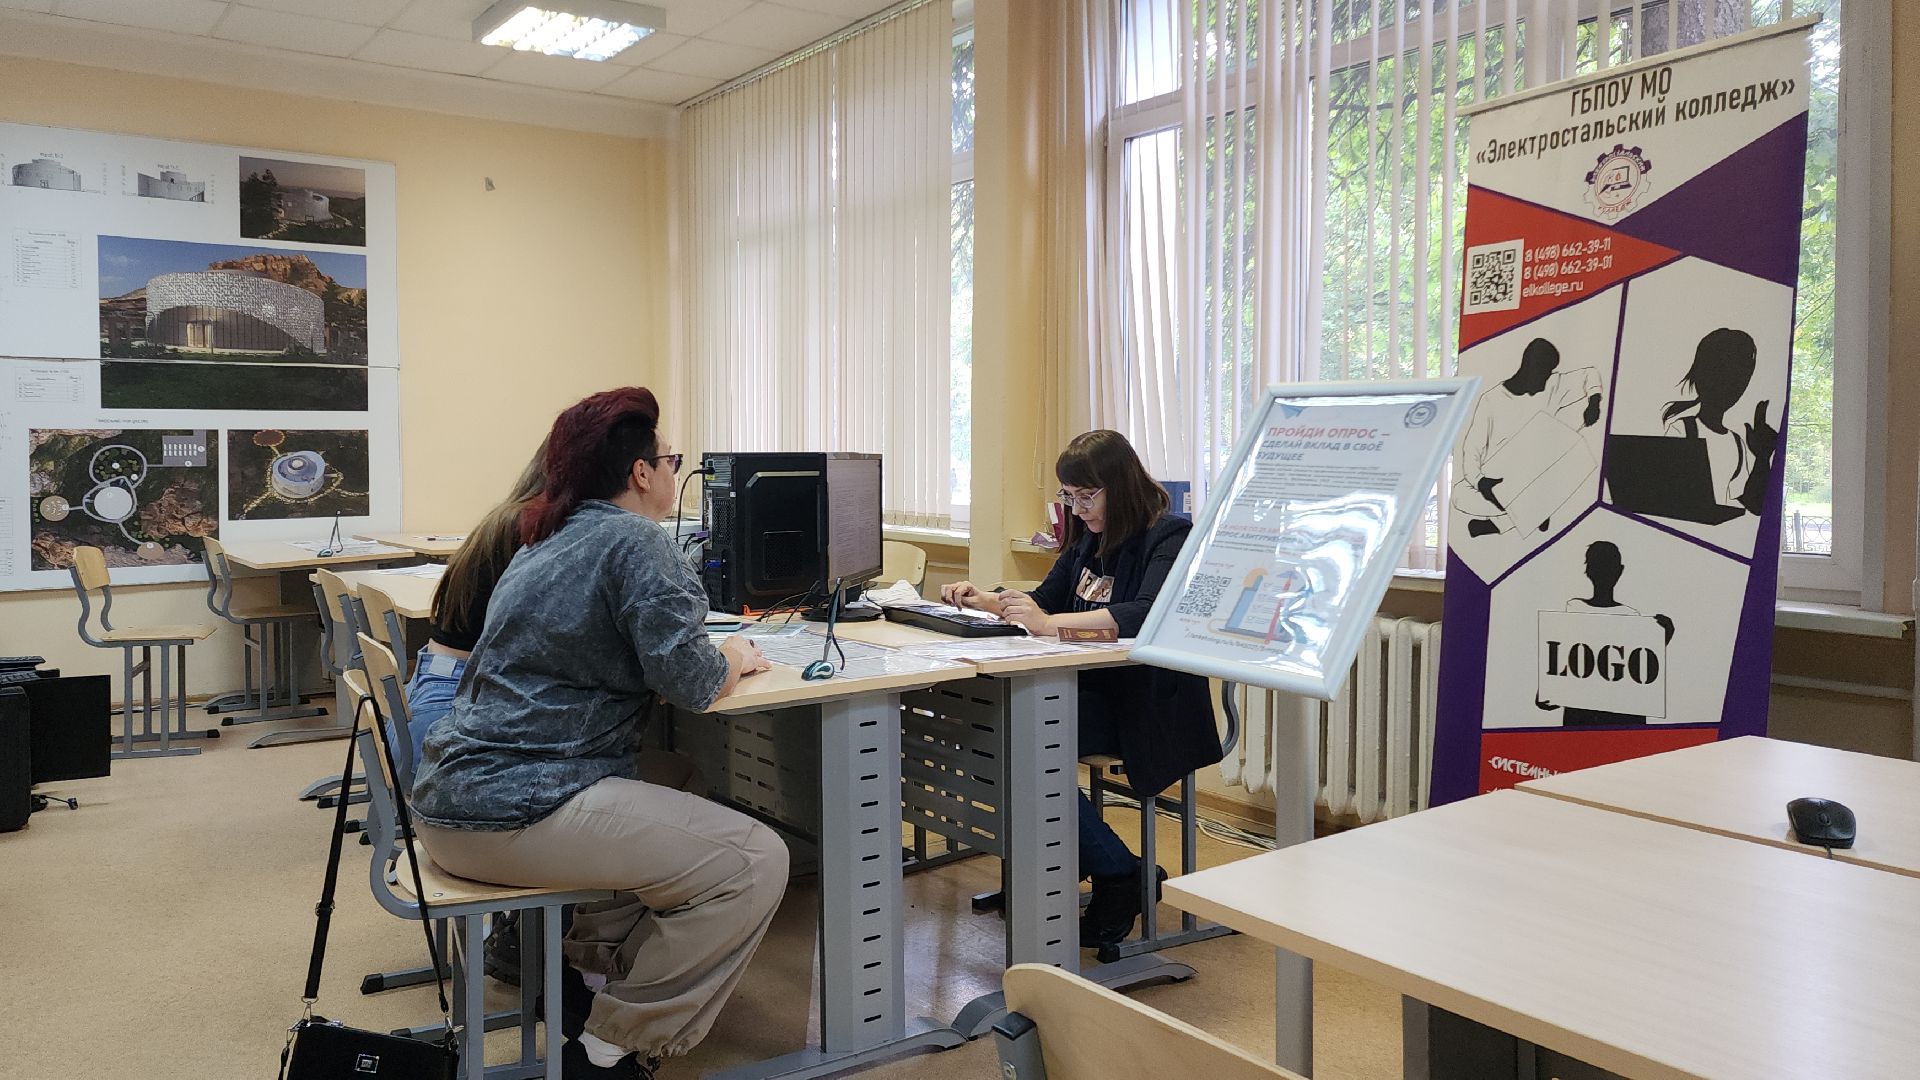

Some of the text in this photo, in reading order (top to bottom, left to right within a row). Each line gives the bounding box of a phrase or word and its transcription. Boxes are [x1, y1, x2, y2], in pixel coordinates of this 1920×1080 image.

[1570, 66, 1673, 117] ГБПОУ МО
[1475, 77, 1796, 165] «Электростальский колледж»
[1524, 248, 1533, 263] 8
[1561, 236, 1612, 258] 662-39-11
[1523, 266, 1532, 280] 8
[1560, 254, 1613, 275] 662-39-01
[1522, 281, 1584, 298] elkollege.ru
[1266, 424, 1325, 440] ПРОЙДИ
[1327, 427, 1379, 440] ОПРОС
[1546, 640, 1660, 685] LOGO
